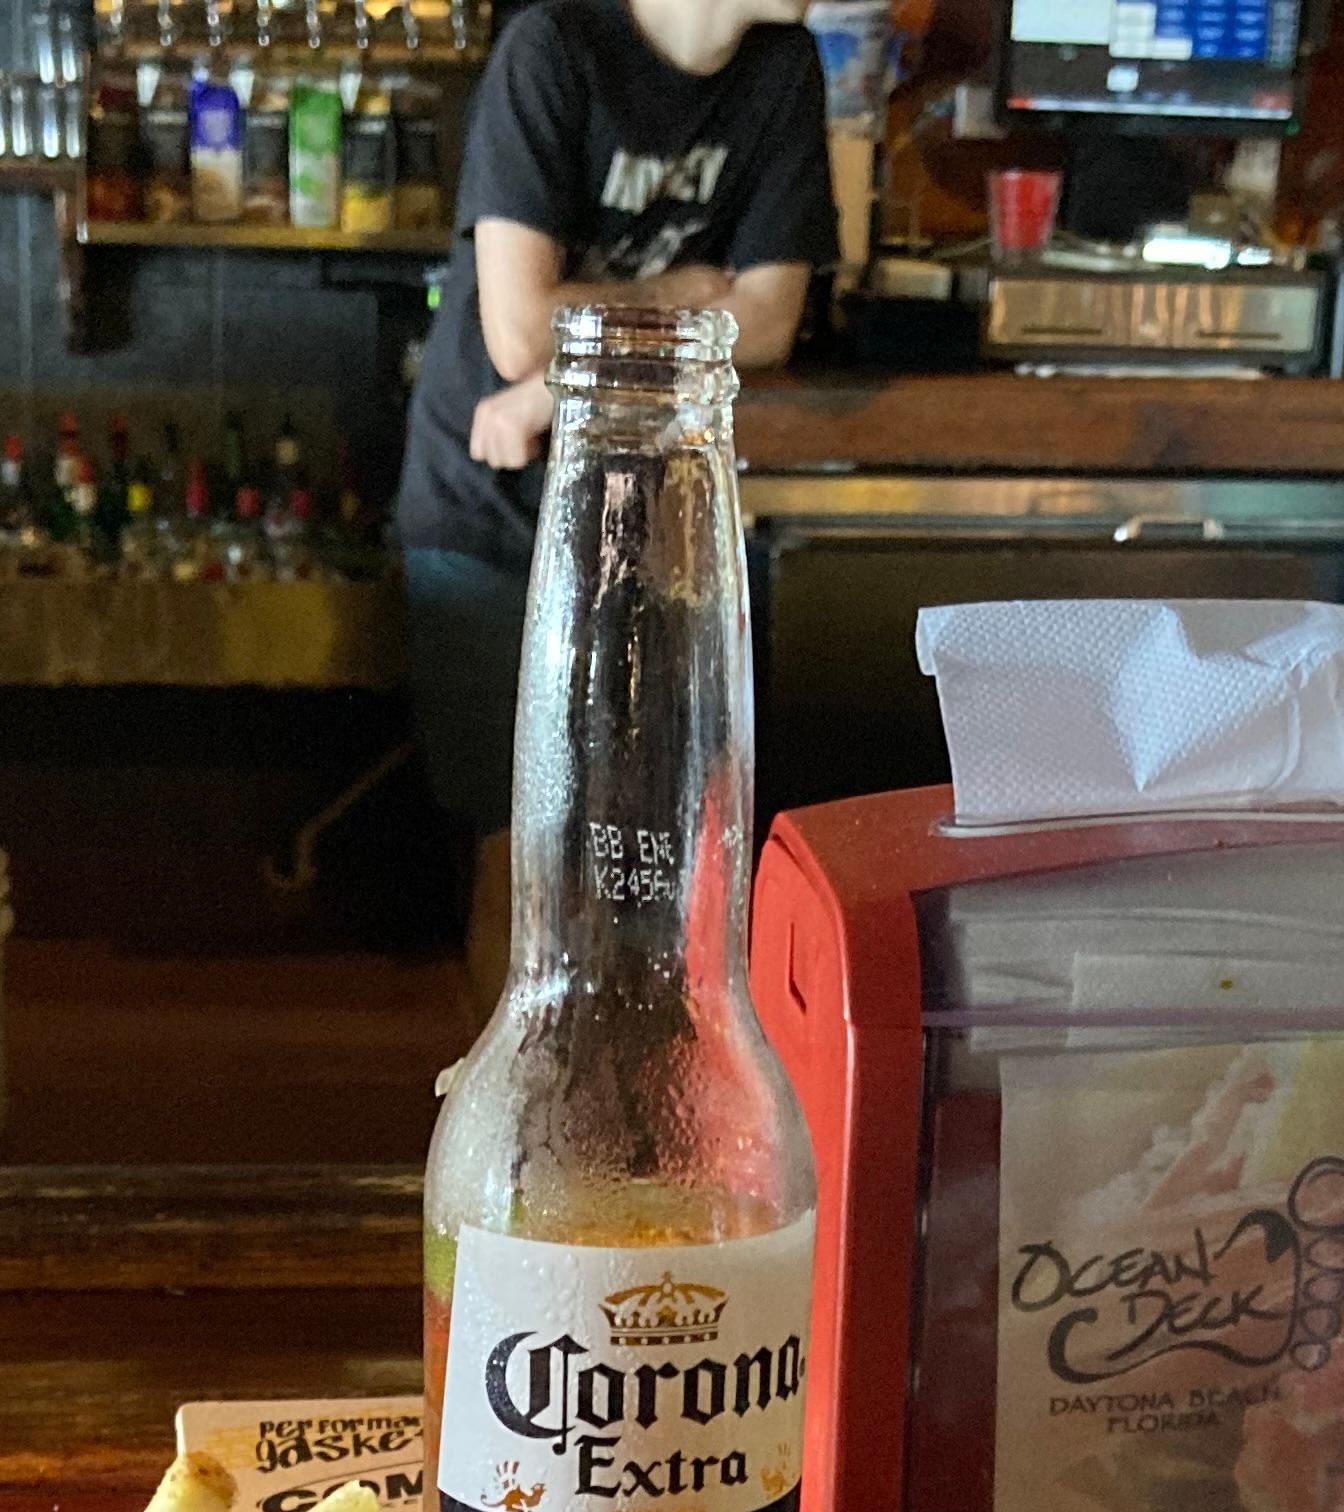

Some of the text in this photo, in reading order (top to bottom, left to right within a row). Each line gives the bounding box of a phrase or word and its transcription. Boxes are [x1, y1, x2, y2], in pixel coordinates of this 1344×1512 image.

[1011, 1227, 1217, 1313] OCEAN
[1106, 1285, 1294, 1362] DECK
[486, 1331, 802, 1456] Corona
[1049, 1390, 1176, 1417] DAYTONA
[1107, 1408, 1222, 1434] FLORIDA
[574, 1435, 749, 1498] Extra
